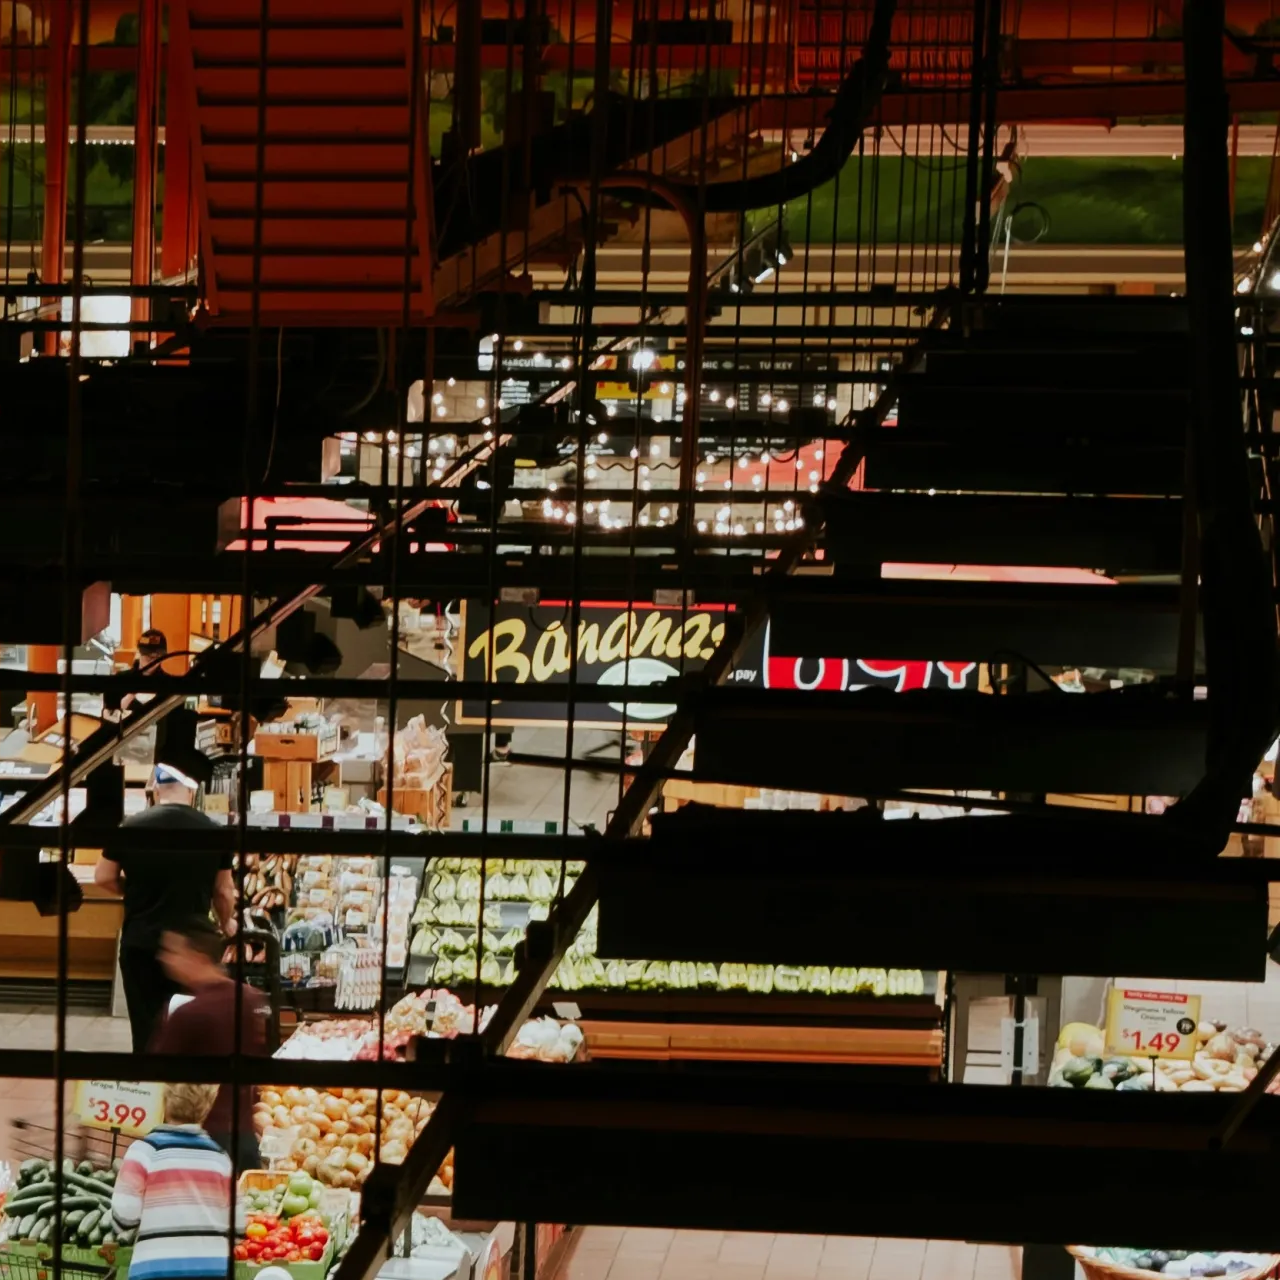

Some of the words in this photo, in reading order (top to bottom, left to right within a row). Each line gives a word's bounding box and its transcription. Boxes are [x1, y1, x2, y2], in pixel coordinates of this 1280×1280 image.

[735, 669, 757, 682] pay
[1122, 1029, 1181, 1053] $1.49
[87, 1097, 147, 1129] $3.99
